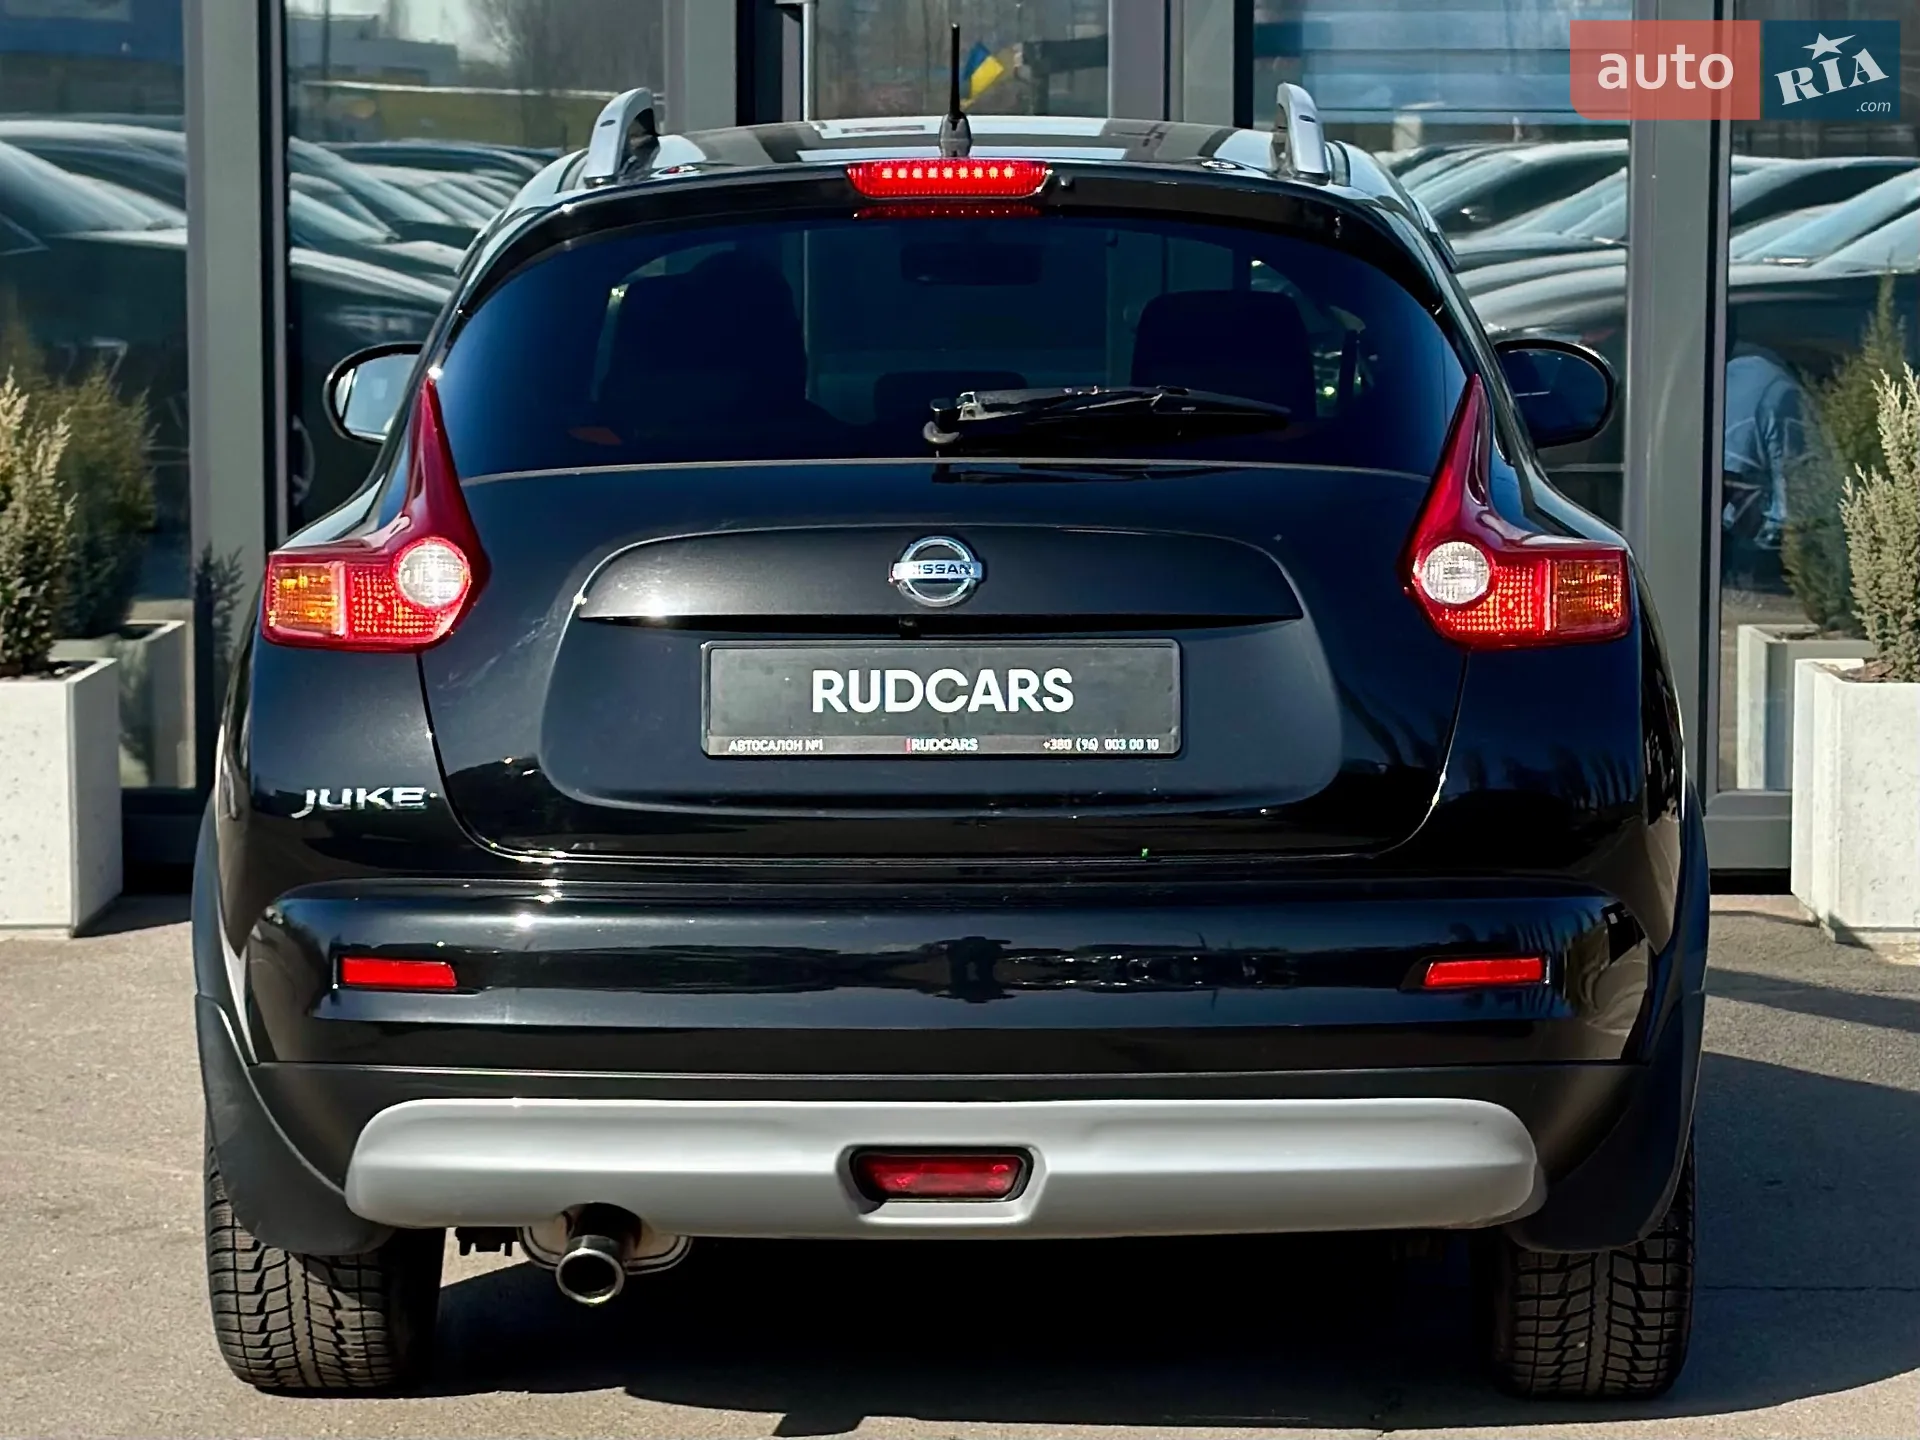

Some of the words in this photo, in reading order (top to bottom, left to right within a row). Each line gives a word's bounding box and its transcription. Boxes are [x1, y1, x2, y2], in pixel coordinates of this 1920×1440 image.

[904, 563, 972, 576] ISSAN
[812, 668, 1074, 713] RUDCARS
[728, 739, 803, 752] АВТОСАЛОН
[911, 738, 979, 751] RUDCARS
[1104, 738, 1127, 751] 003
[1129, 738, 1144, 751] 00
[1145, 738, 1160, 751] 10
[291, 786, 427, 819] JUKE
